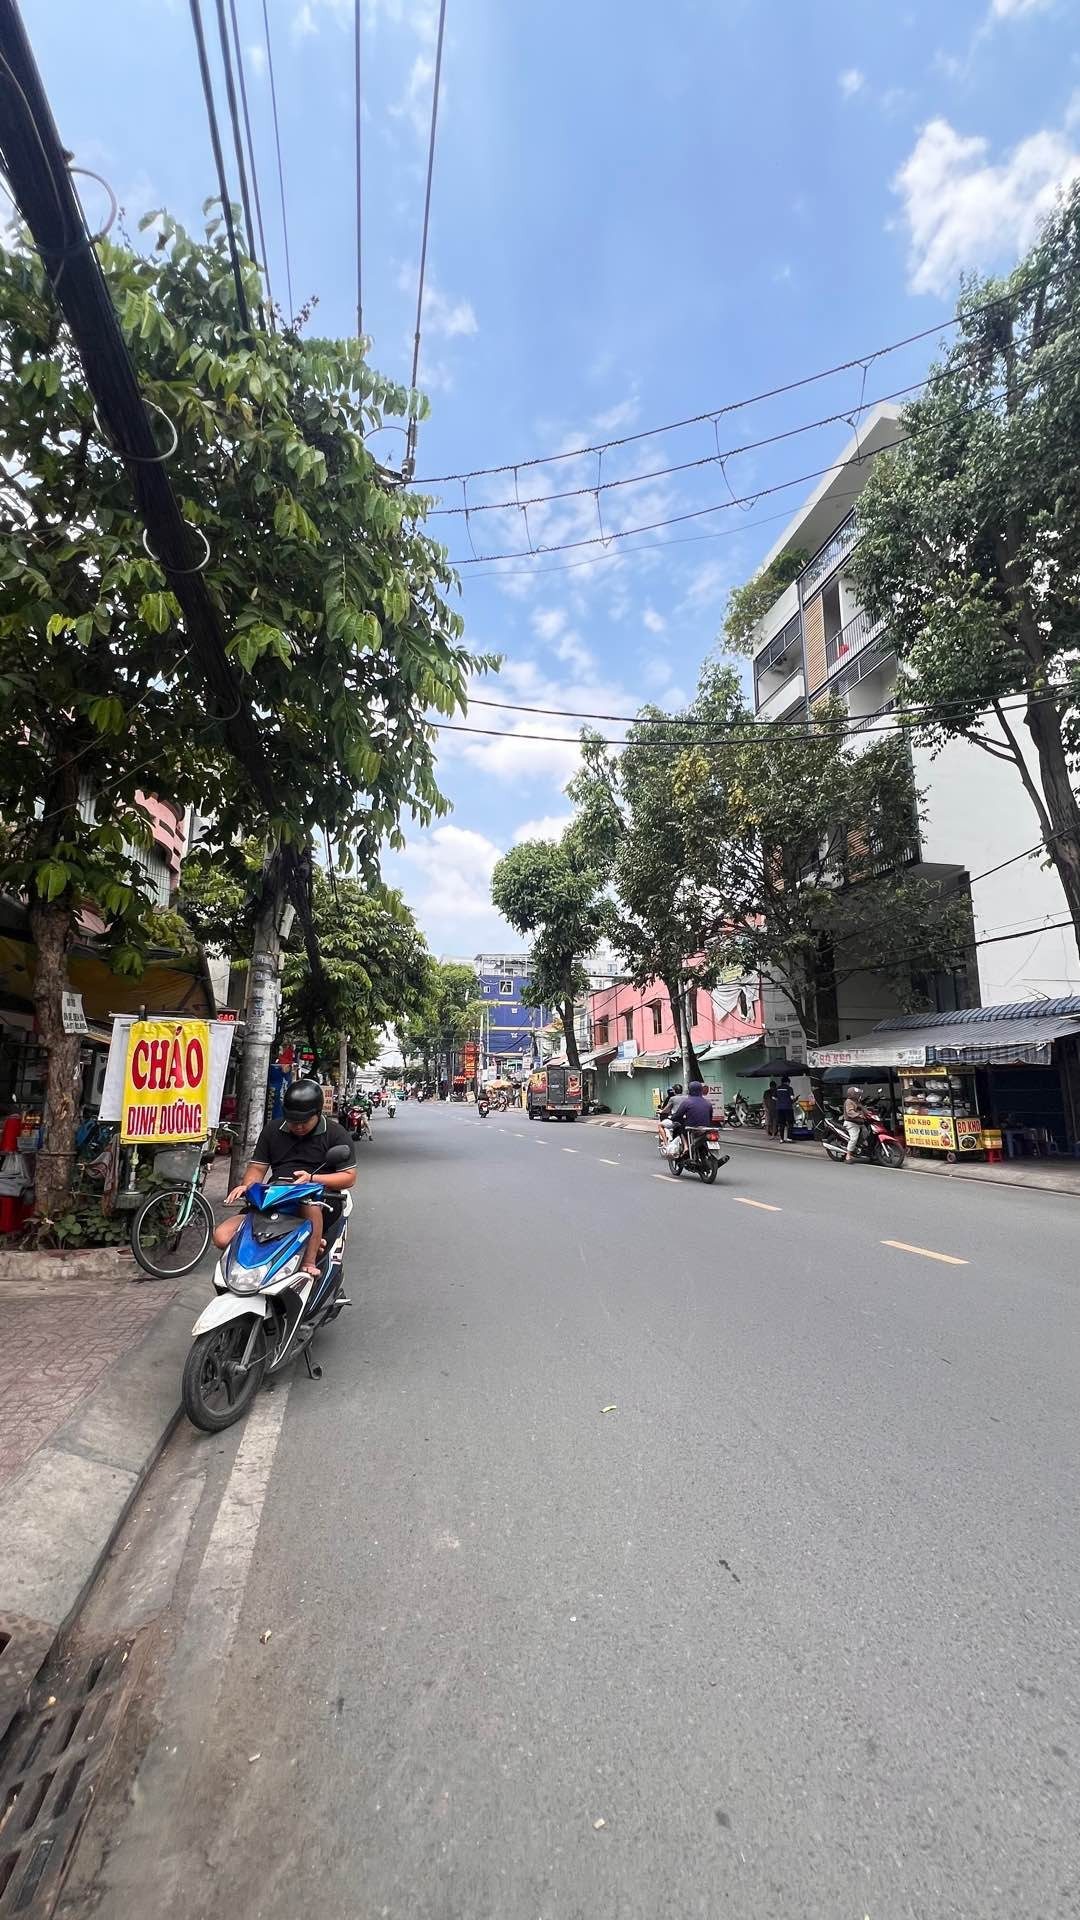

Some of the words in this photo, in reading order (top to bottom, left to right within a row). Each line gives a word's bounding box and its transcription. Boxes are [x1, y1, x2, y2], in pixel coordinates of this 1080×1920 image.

[132, 1026, 204, 1090] CHÁO
[127, 1105, 157, 1136] DINH
[159, 1098, 202, 1135] DƯỠNG
[968, 1119, 981, 1133] KHO
